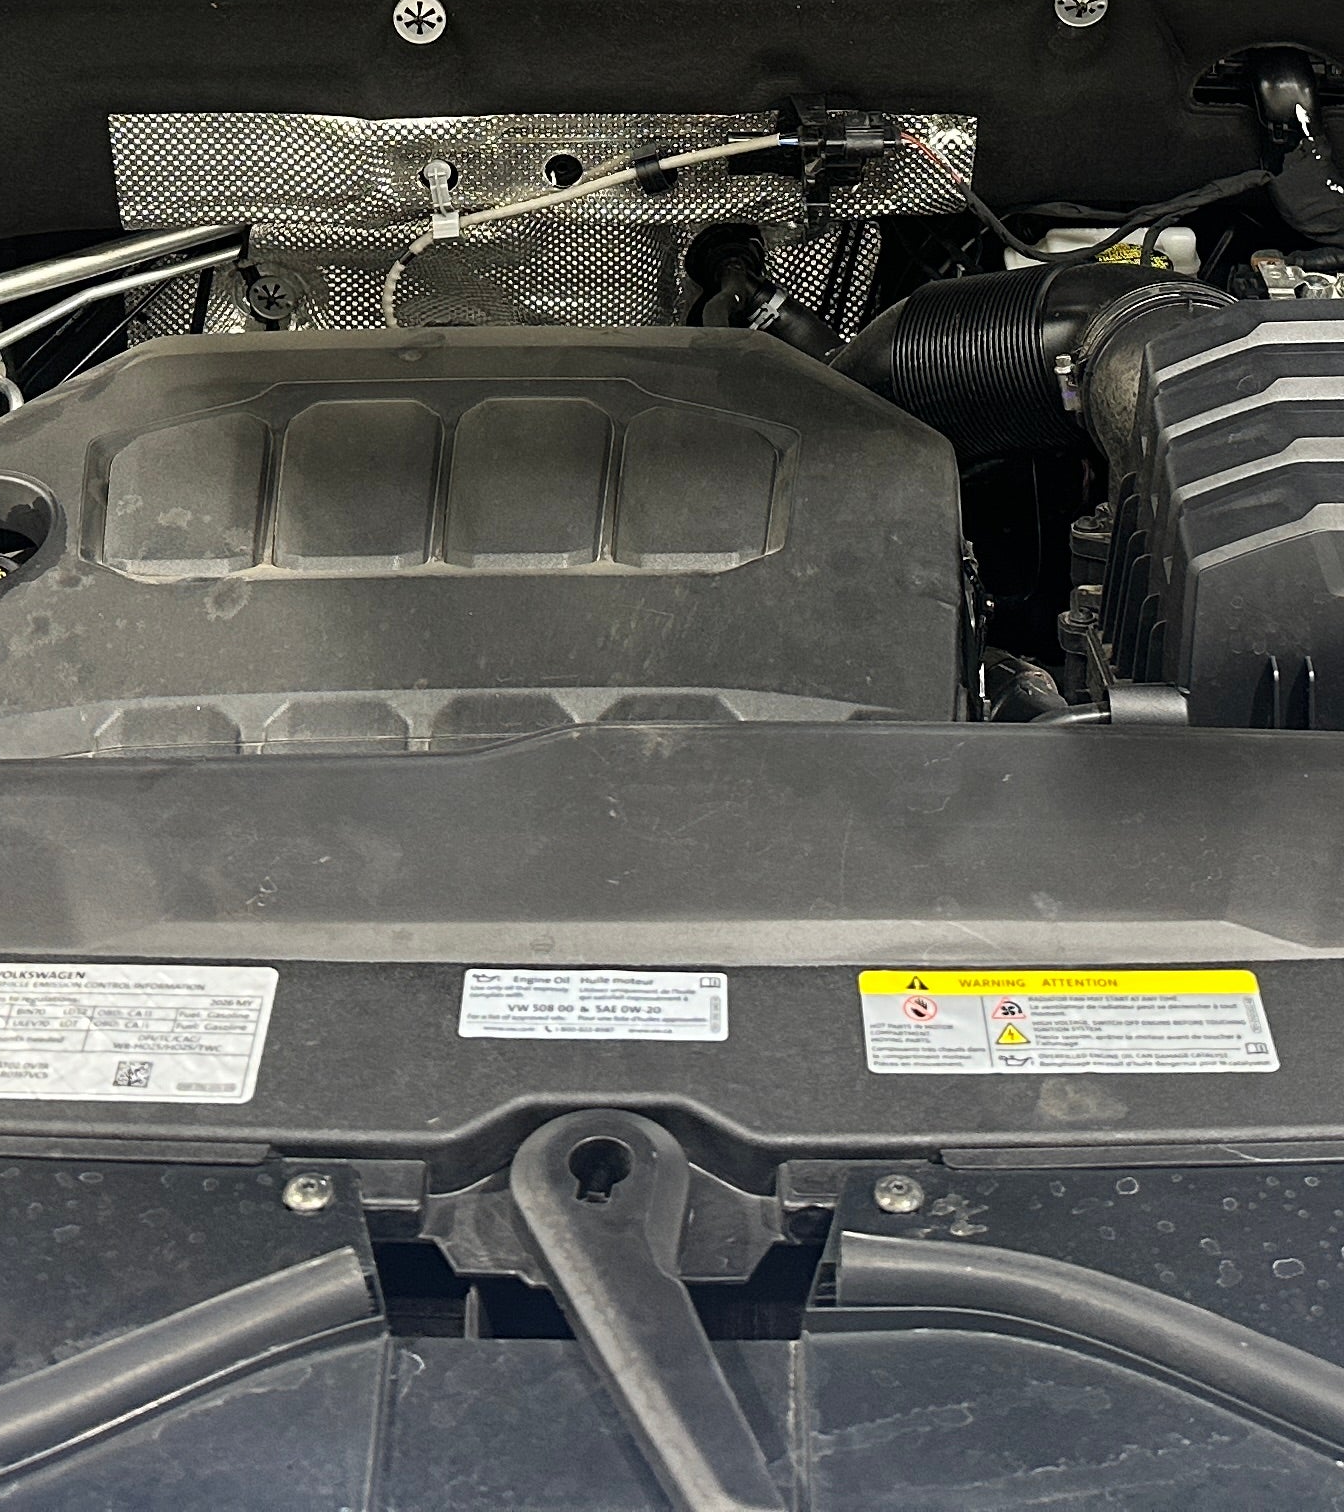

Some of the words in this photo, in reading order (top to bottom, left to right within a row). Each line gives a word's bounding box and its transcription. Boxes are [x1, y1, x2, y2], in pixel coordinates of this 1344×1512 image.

[513, 976, 552, 985] Engine
[553, 976, 570, 984] Oil
[580, 977, 610, 985] Huile
[612, 977, 654, 986] moteur
[959, 979, 1026, 987] WARNING
[1042, 978, 1118, 987] ATTENTION
[33, 981, 82, 989] EMISSION
[84, 982, 131, 990] CONTROL
[134, 983, 206, 991] INFORMATION
[508, 1004, 529, 1012] VW
[533, 1004, 555, 1013] 508
[557, 1005, 575, 1013] 00
[596, 1005, 617, 1014] SAE
[207, 1012, 250, 1020] Gasoline
[204, 1023, 247, 1031] Gasoline
